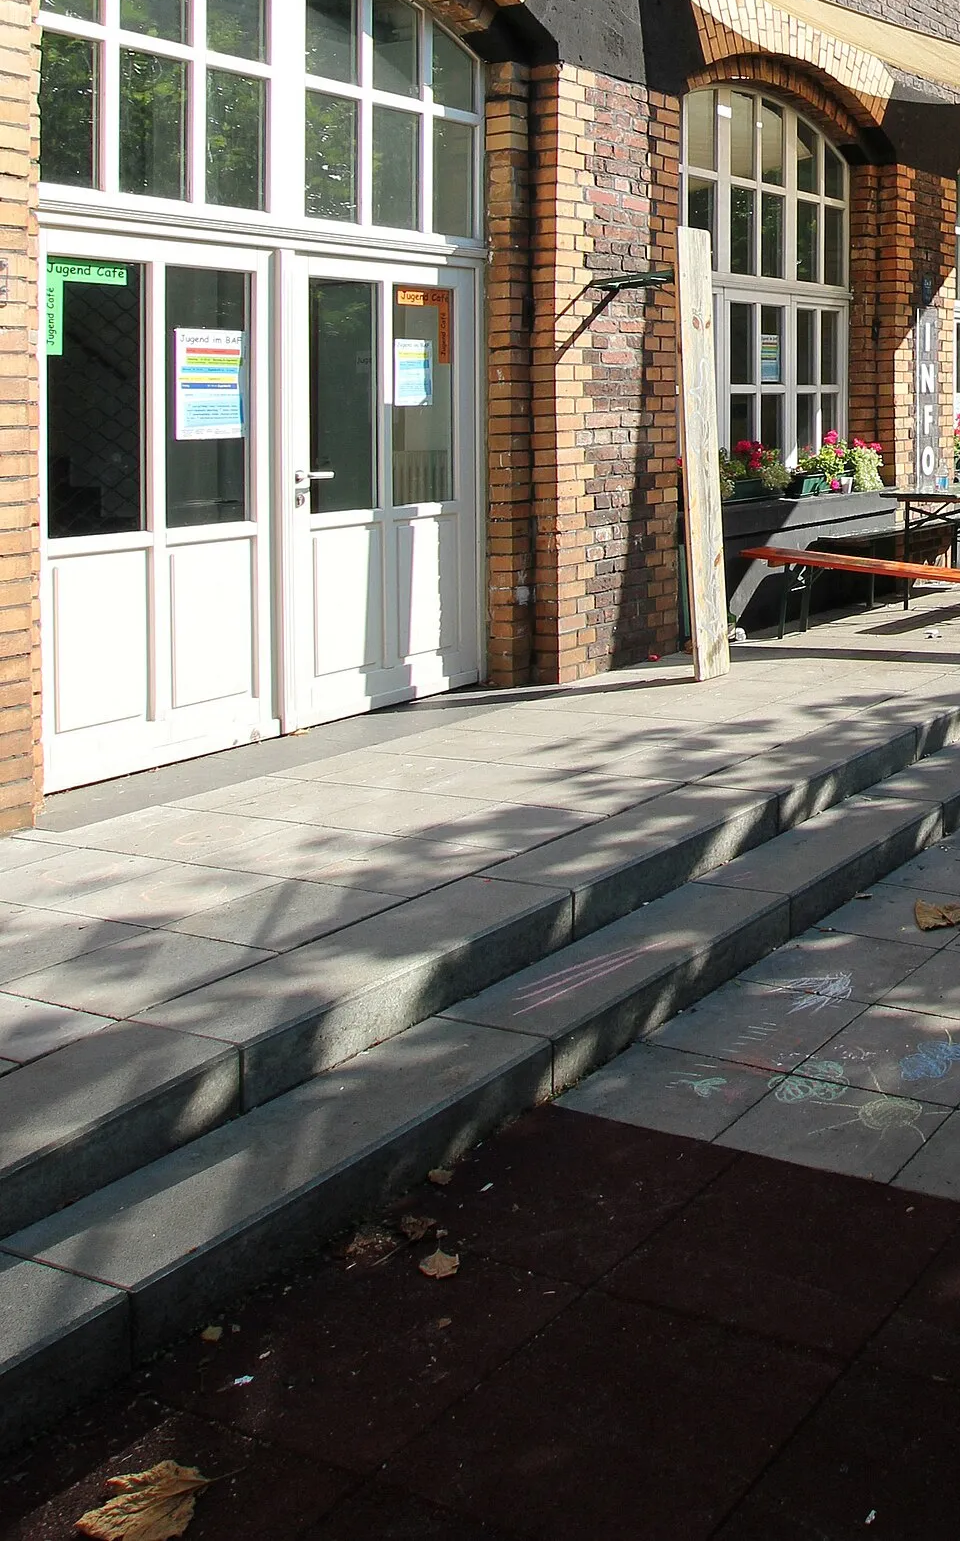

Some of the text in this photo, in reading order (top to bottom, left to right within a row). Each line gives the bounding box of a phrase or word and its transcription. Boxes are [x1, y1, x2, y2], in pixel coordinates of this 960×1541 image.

[46, 262, 125, 278] Jugend Café
[400, 290, 428, 302] Jugend
[46, 313, 57, 346] Jugend
[179, 334, 209, 345] Jugend
[921, 322, 935, 476] INFO
